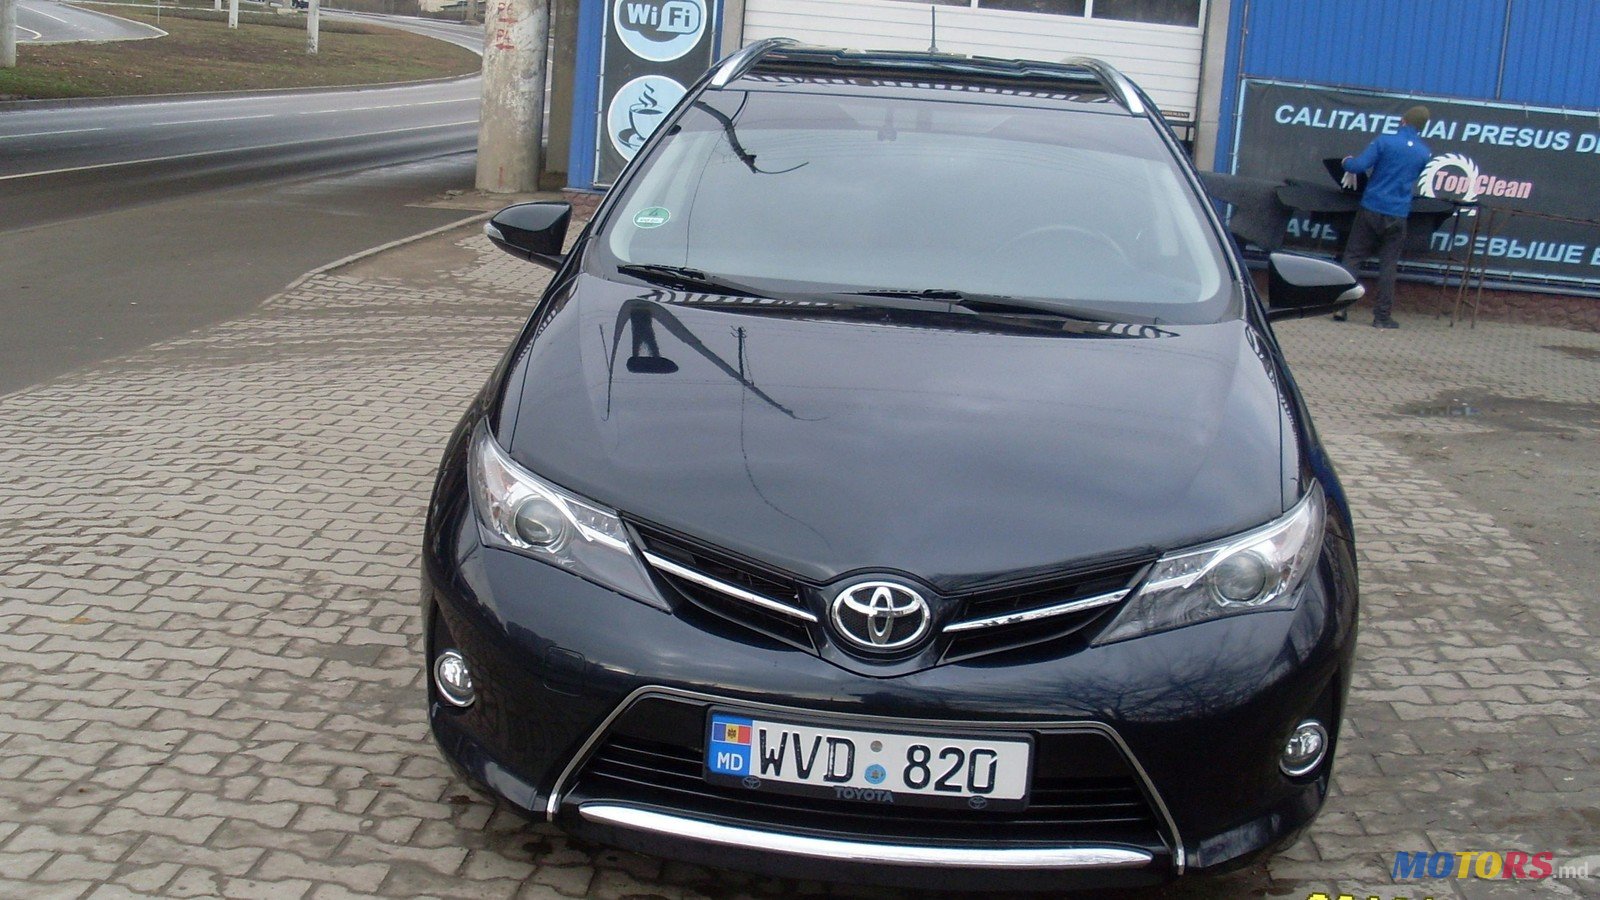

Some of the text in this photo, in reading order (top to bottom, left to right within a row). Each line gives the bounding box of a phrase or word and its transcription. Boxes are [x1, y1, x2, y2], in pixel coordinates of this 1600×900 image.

[1275, 104, 1402, 135] CALITATE
[1461, 123, 1571, 151] PRESUS
[1430, 231, 1585, 264] ПРЕВЫШЕ
[716, 751, 743, 771] MD
[759, 729, 998, 794] WVD 820
[834, 786, 894, 803] TOYOTA
